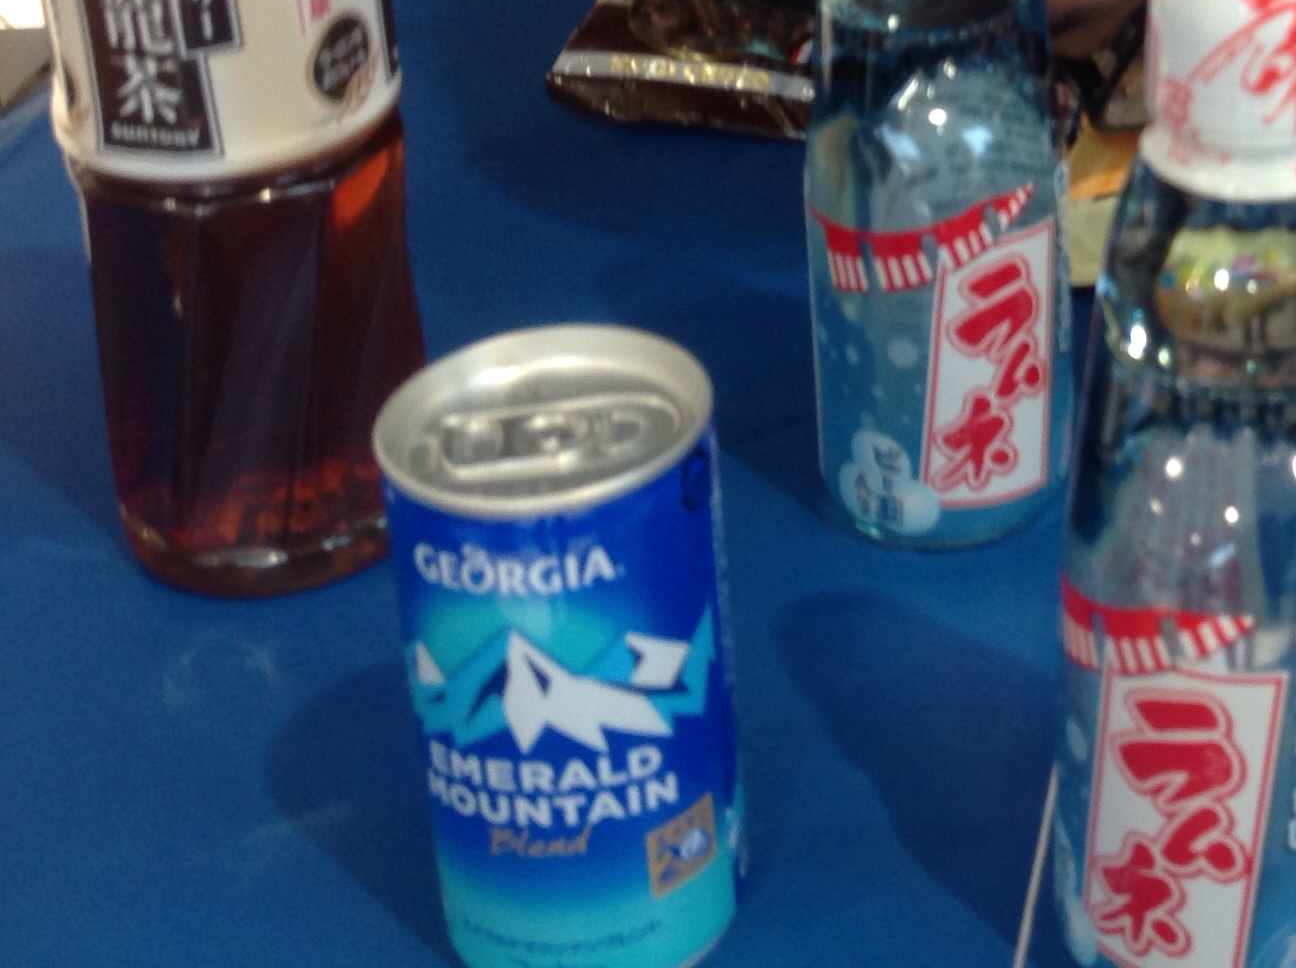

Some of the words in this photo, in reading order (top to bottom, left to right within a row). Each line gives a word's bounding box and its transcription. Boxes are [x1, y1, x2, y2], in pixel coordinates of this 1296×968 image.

[931, 252, 1044, 491] ラムネ
[428, 739, 663, 794] EMERALD
[426, 770, 679, 828] MOUNTAIN
[1098, 689, 1247, 958] ラムネ
[489, 823, 593, 858] Blend
